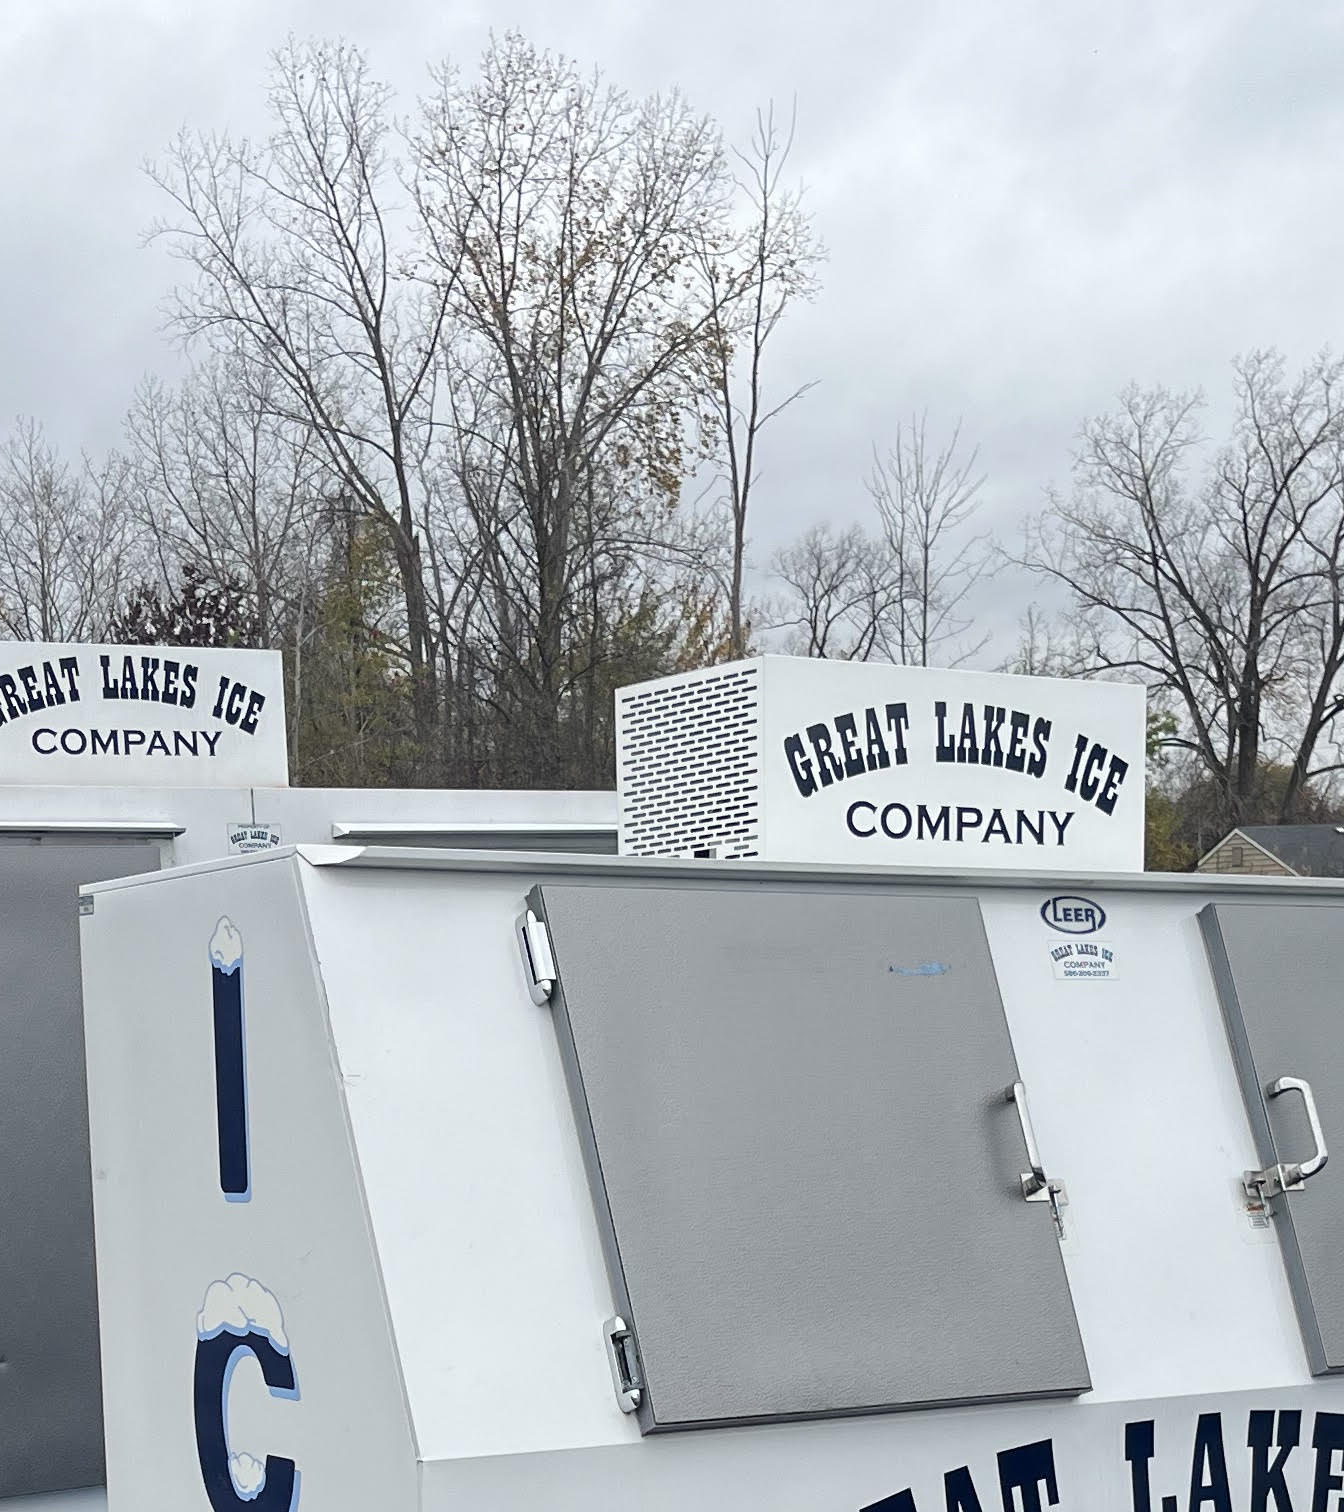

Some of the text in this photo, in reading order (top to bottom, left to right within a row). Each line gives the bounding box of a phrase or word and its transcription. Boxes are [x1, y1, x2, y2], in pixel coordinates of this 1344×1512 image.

[99, 655, 199, 709] LAKES
[211, 675, 266, 736] ICE
[32, 728, 222, 757] COMPANY
[784, 701, 1129, 816] GREAT LAKES ICE
[846, 800, 1075, 847] COMPANY
[1052, 898, 1097, 931] LEER
